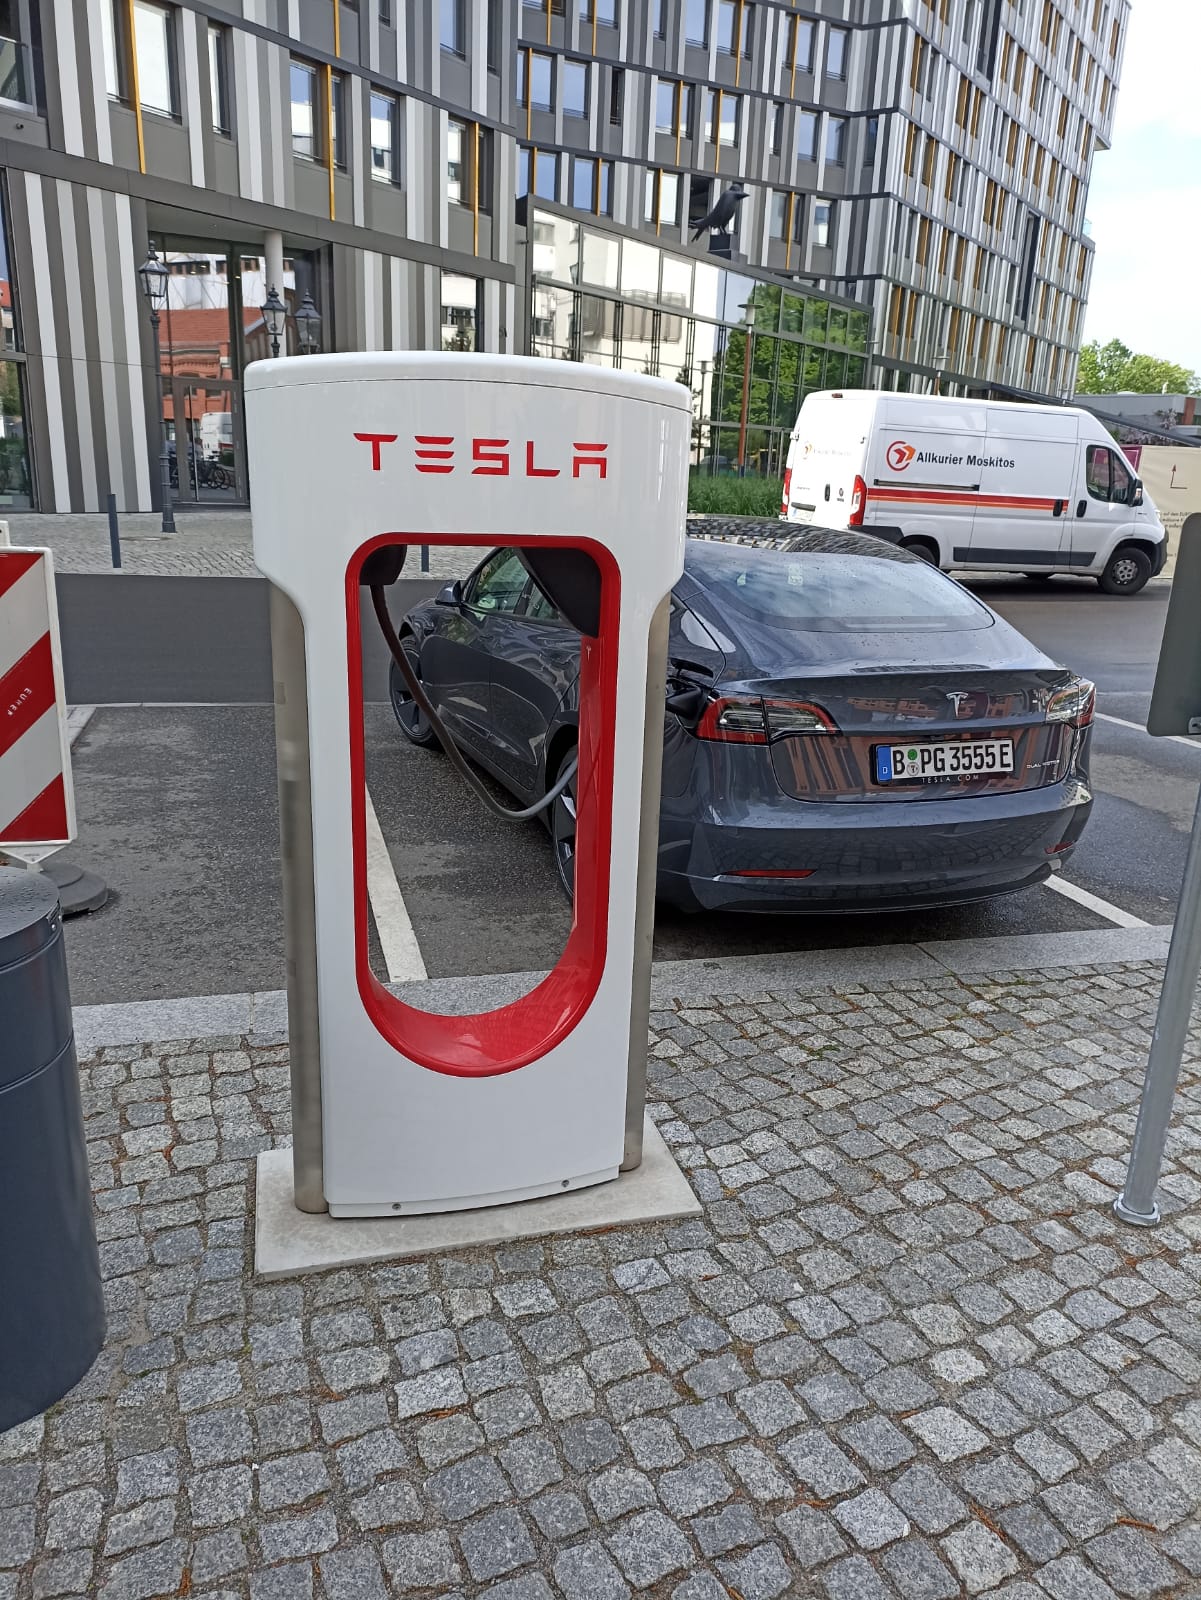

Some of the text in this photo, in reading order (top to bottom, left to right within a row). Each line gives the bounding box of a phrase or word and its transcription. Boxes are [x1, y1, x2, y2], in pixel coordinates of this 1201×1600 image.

[352, 431, 609, 479] TESLA
[916, 451, 1016, 469] Allkurier Moskitos
[892, 749, 906, 776] B
